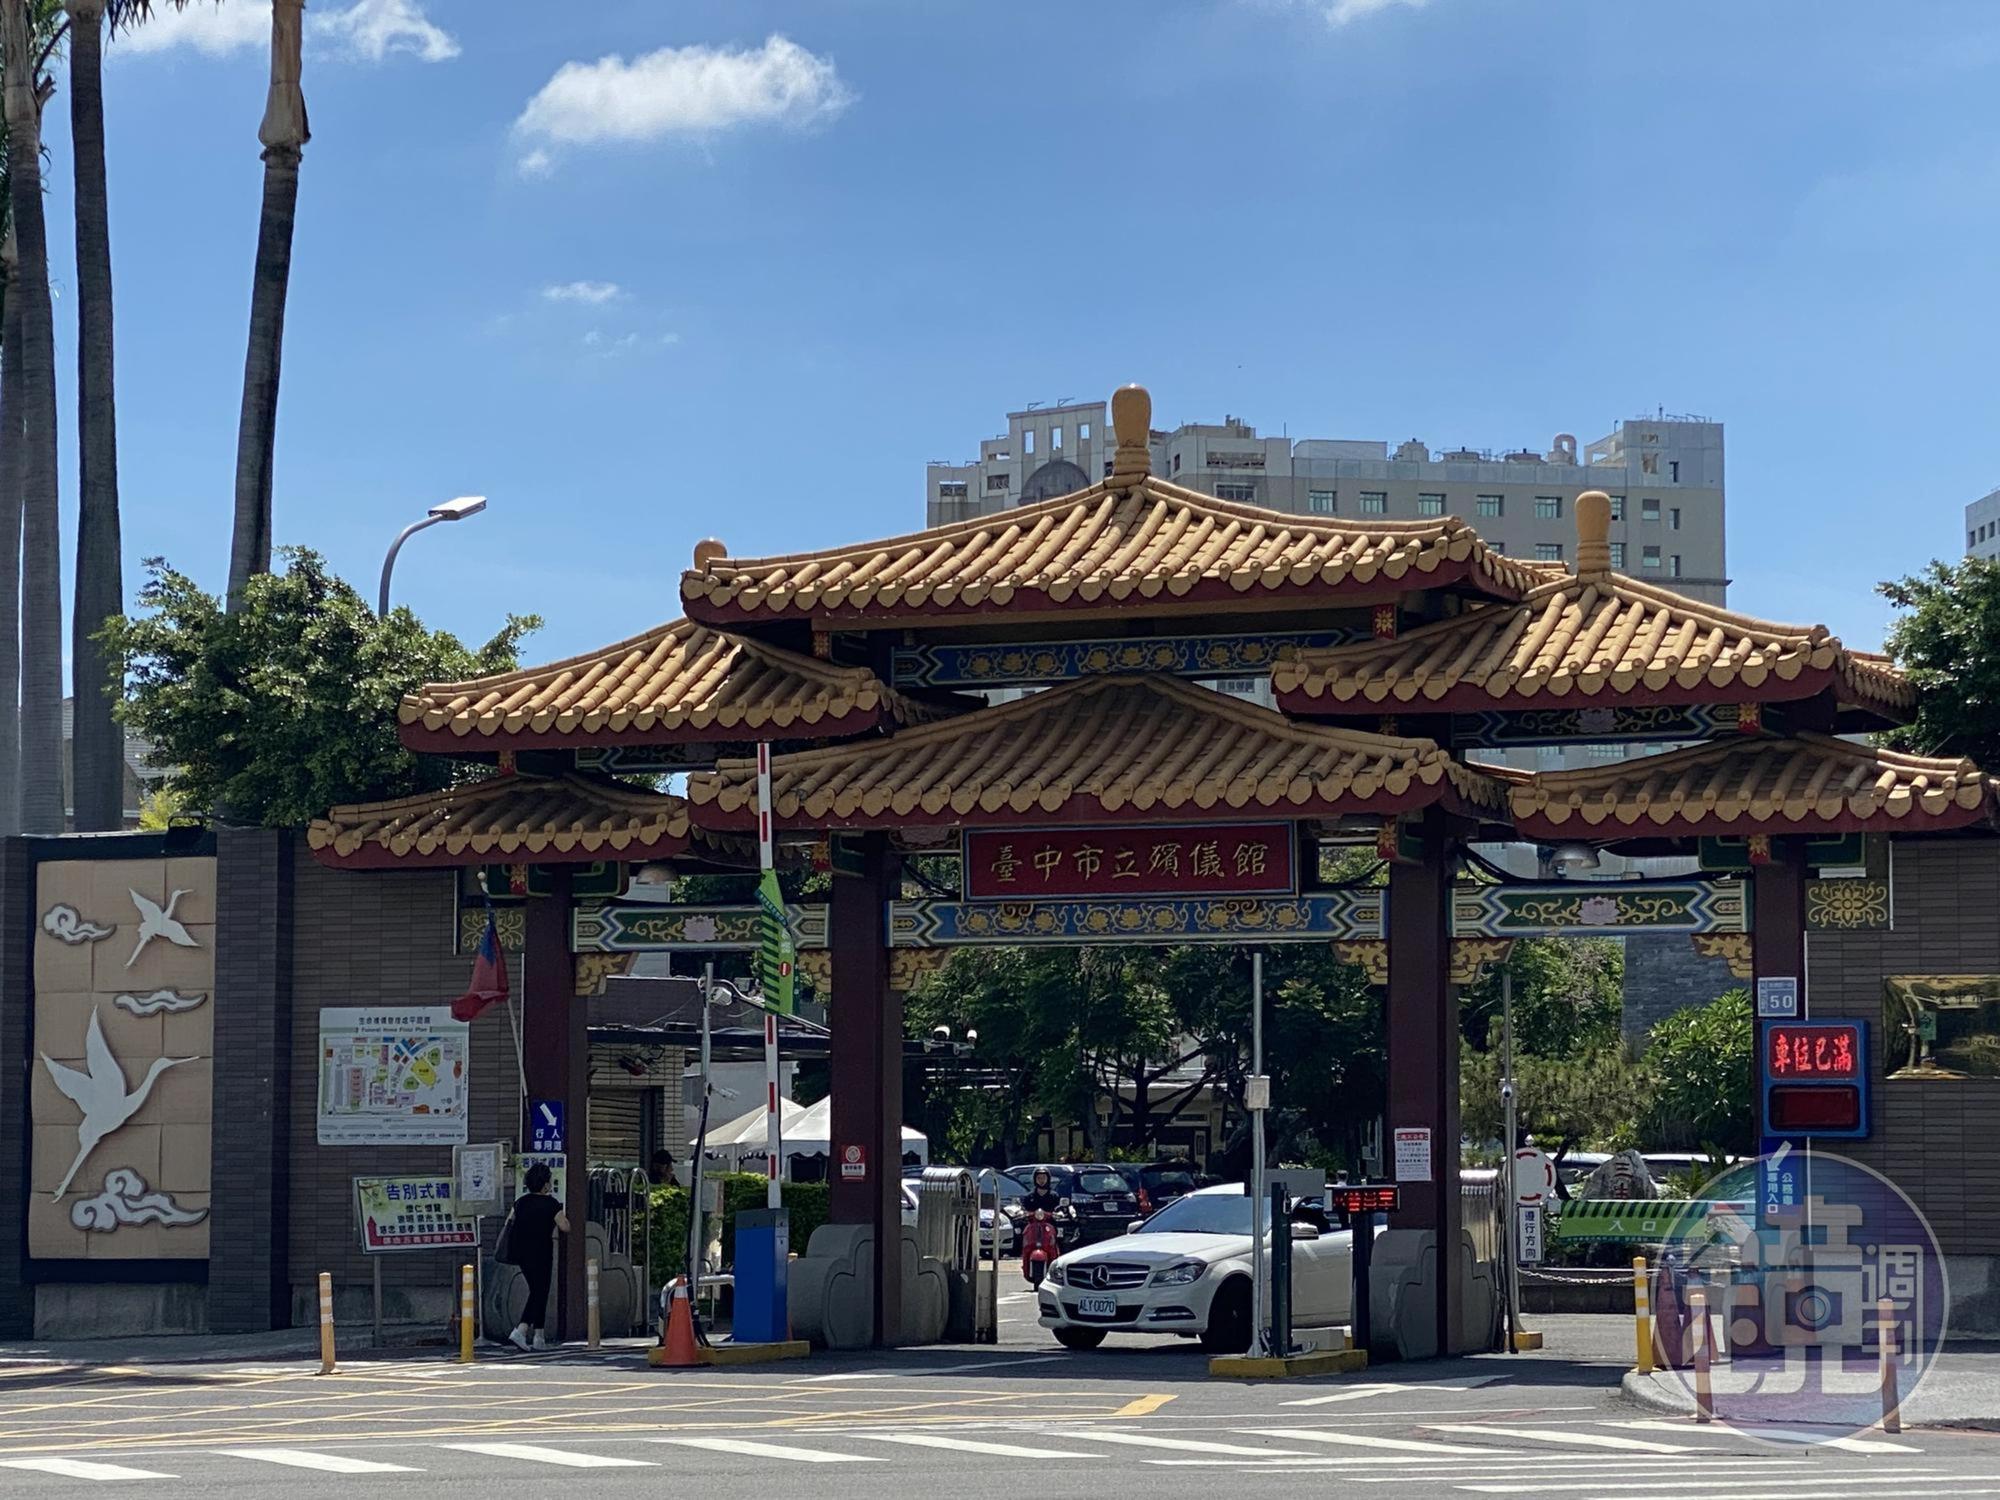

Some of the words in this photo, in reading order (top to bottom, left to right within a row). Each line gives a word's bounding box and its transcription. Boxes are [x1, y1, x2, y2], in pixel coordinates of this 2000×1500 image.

[990, 840, 1269, 883] 臺中市立殯儀館
[1769, 995, 1793, 1009] 50
[1774, 1034, 1853, 1074] 車位已滿
[535, 1129, 560, 1139] 行人
[386, 1182, 453, 1201] 告別式禮
[1608, 1220, 1657, 1232] 入口
